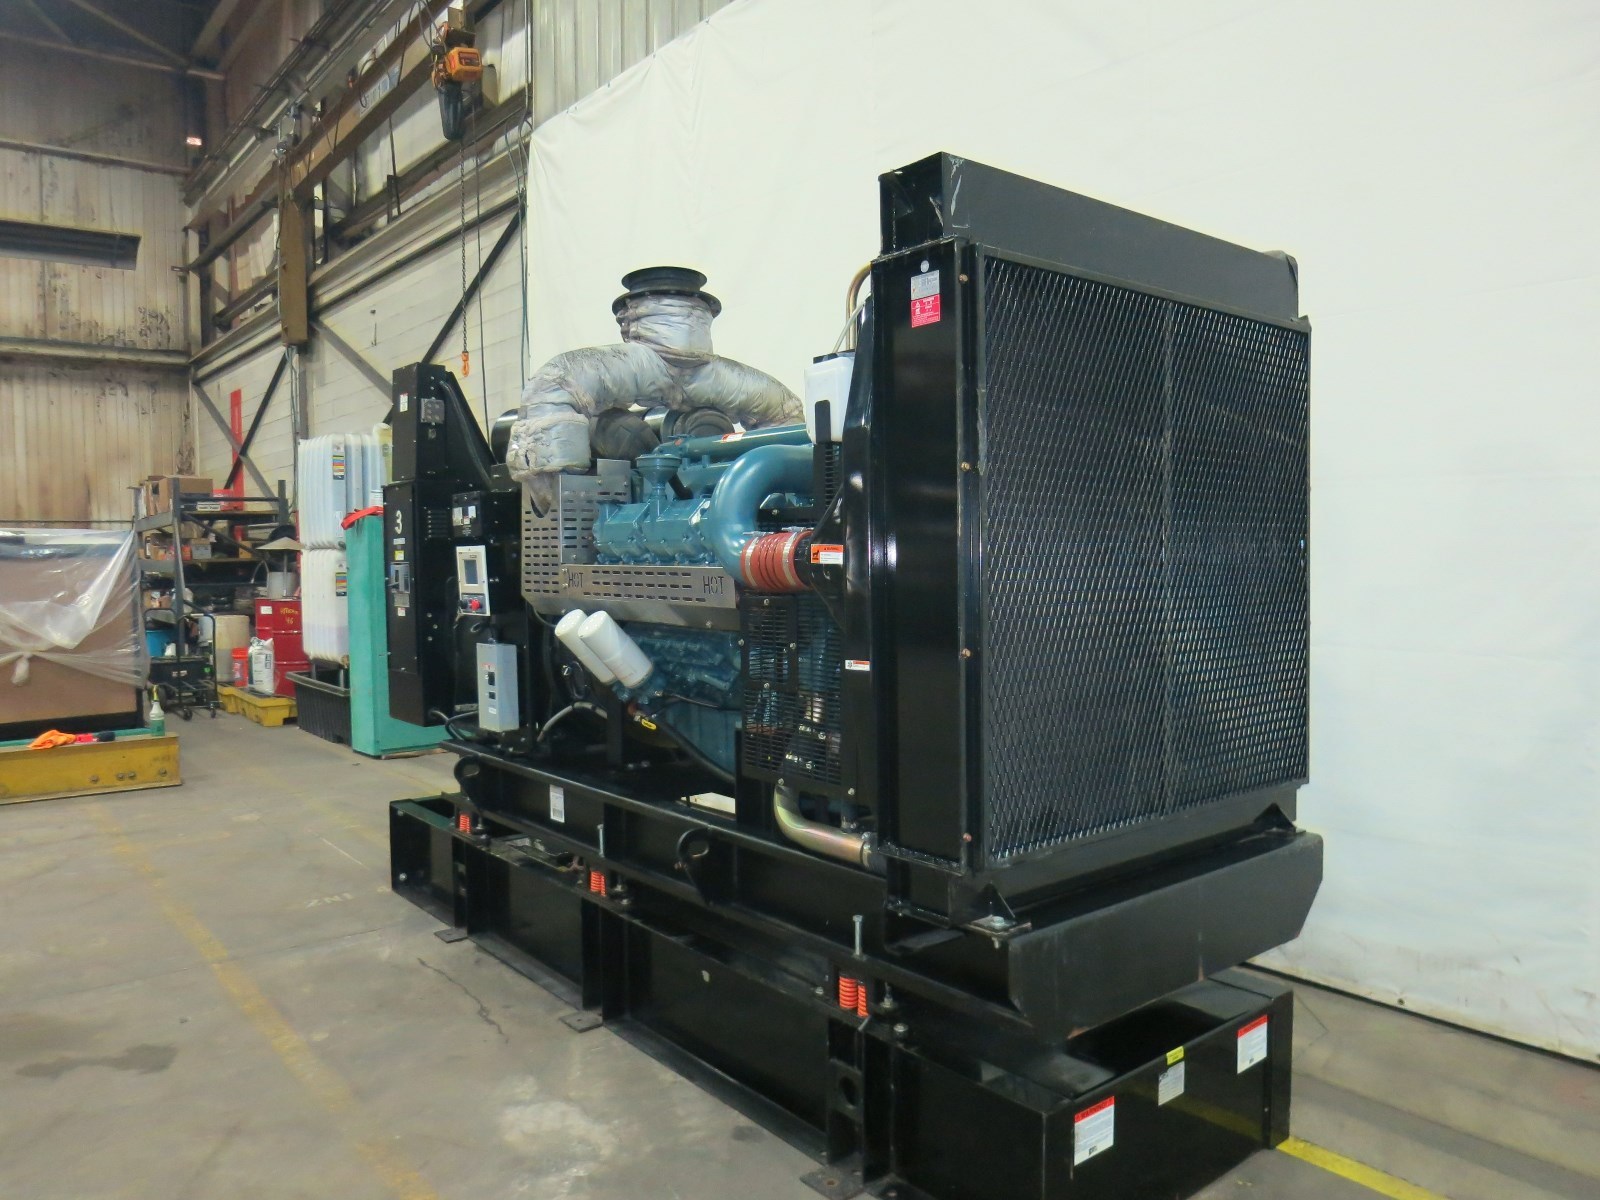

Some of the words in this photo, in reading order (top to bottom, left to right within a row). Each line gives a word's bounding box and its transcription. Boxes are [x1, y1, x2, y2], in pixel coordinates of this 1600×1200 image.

[394, 510, 403, 535] 3
[568, 571, 585, 588] HOT
[702, 575, 725, 595] HOT
